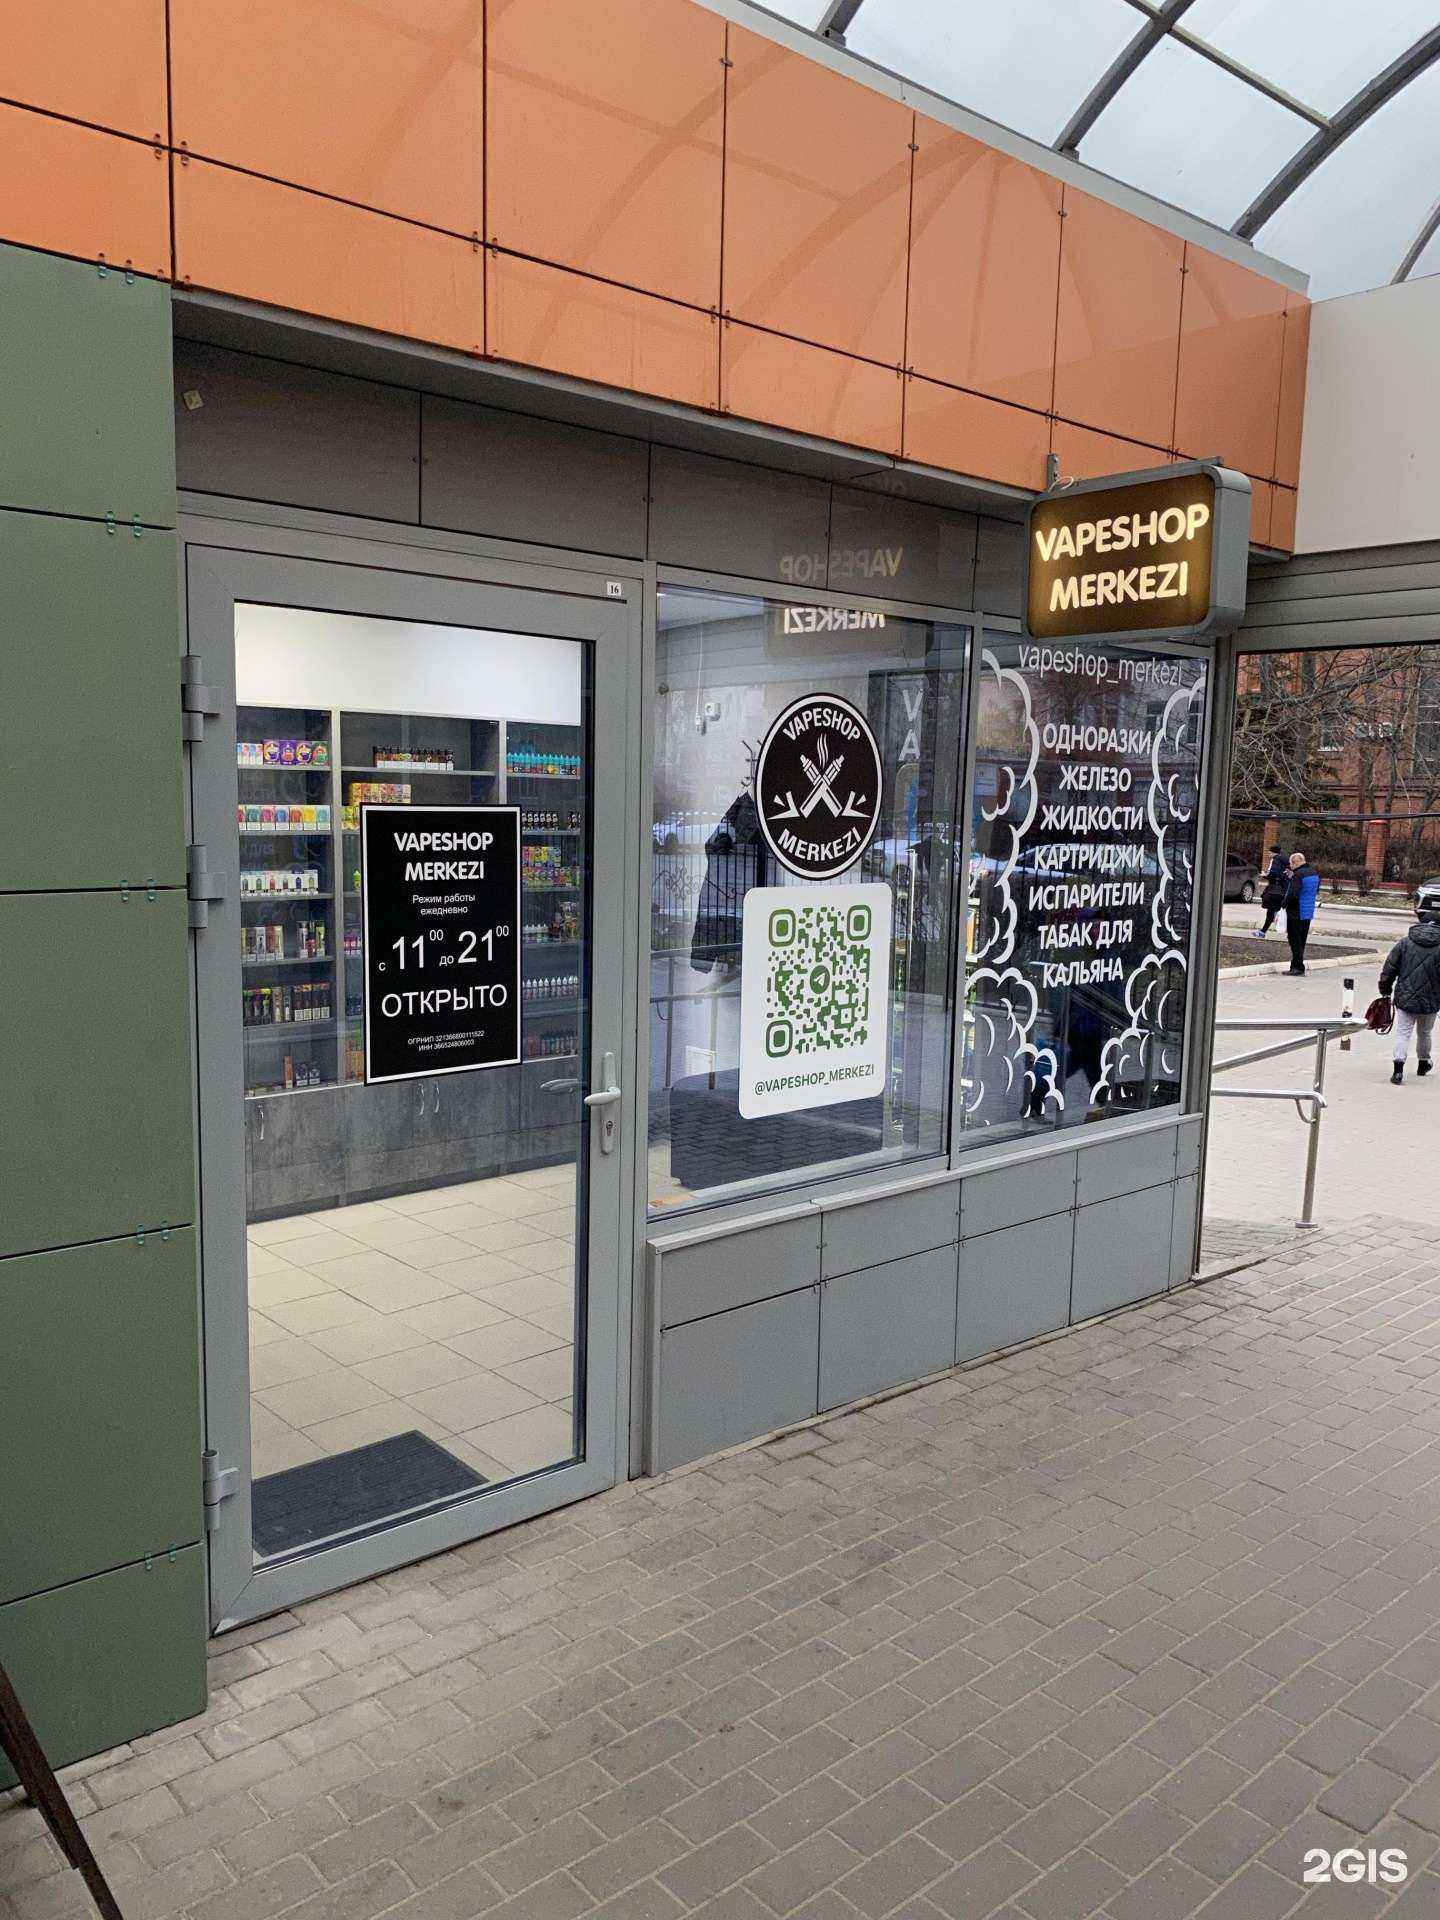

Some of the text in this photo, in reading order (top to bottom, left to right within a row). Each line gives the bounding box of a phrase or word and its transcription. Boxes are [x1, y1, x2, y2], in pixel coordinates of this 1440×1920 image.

[1035, 503, 1210, 562] VAPESHOP
[610, 585, 619, 594] 16
[1049, 561, 1189, 612] MERKEZI
[1018, 645, 1182, 686] vapeshop_merkezi
[783, 708, 861, 742] VAPESHOP
[1042, 723, 1151, 754] ОДНОРАЗКИ
[1059, 765, 1132, 792] ЖЕЛЕЗО
[1040, 805, 1144, 835] ЖИДКОСТИ
[393, 832, 494, 851] VAPESHOP
[777, 827, 862, 862] MERKEZI
[404, 861, 485, 881] MERKEZI
[1034, 844, 1145, 874] КАРТРИДЖИ
[412, 893, 476, 904] Режим работы
[420, 906, 468, 916] ежедневно
[1029, 882, 1145, 911] ИСПАРИТЕЛИ
[1038, 920, 1133, 950] ТАБАК ДЛЯ
[439, 955, 455, 967] до
[1042, 957, 1124, 988] КАЛЬЯНА
[381, 984, 508, 1017] ОТКРЫТО
[407, 1035, 434, 1045] ОГРНИП
[418, 1043, 433, 1051] ИНН
[754, 1064, 874, 1095] @VAPESHOP_MERKEZI
